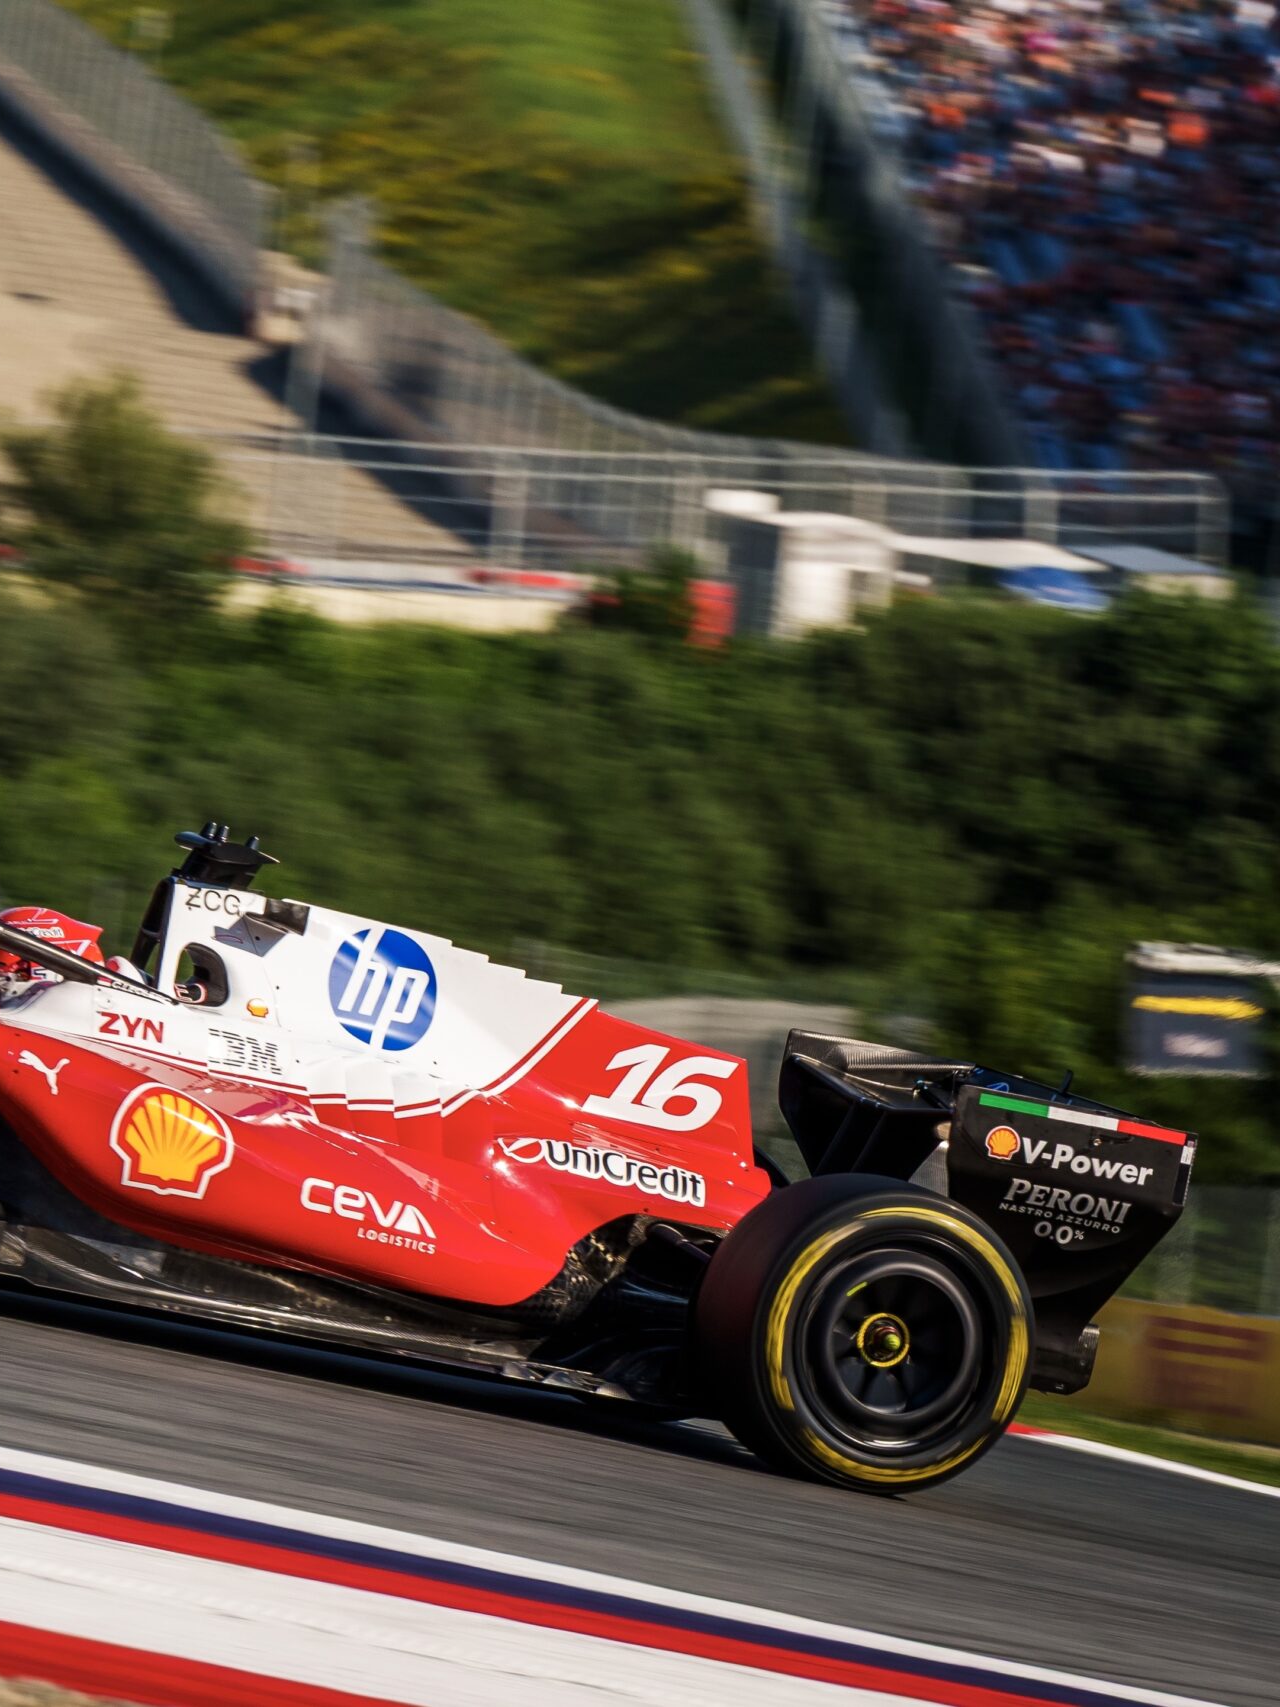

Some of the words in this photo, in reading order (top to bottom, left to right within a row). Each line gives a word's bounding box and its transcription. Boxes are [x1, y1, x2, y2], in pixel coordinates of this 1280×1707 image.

[335, 928, 432, 1051] hp
[99, 1011, 164, 1043] ZYN
[582, 1043, 739, 1132] 16
[545, 1139, 703, 1203] UniCredit
[1022, 1136, 1154, 1186] V-Power
[998, 1201, 1054, 1219] NASTRO
[1056, 1213, 1121, 1234] AZZURRO
[1003, 1177, 1133, 1224] PERONI
[356, 1227, 437, 1255] LOGISTICS
[1033, 1219, 1085, 1245] 0.0%
